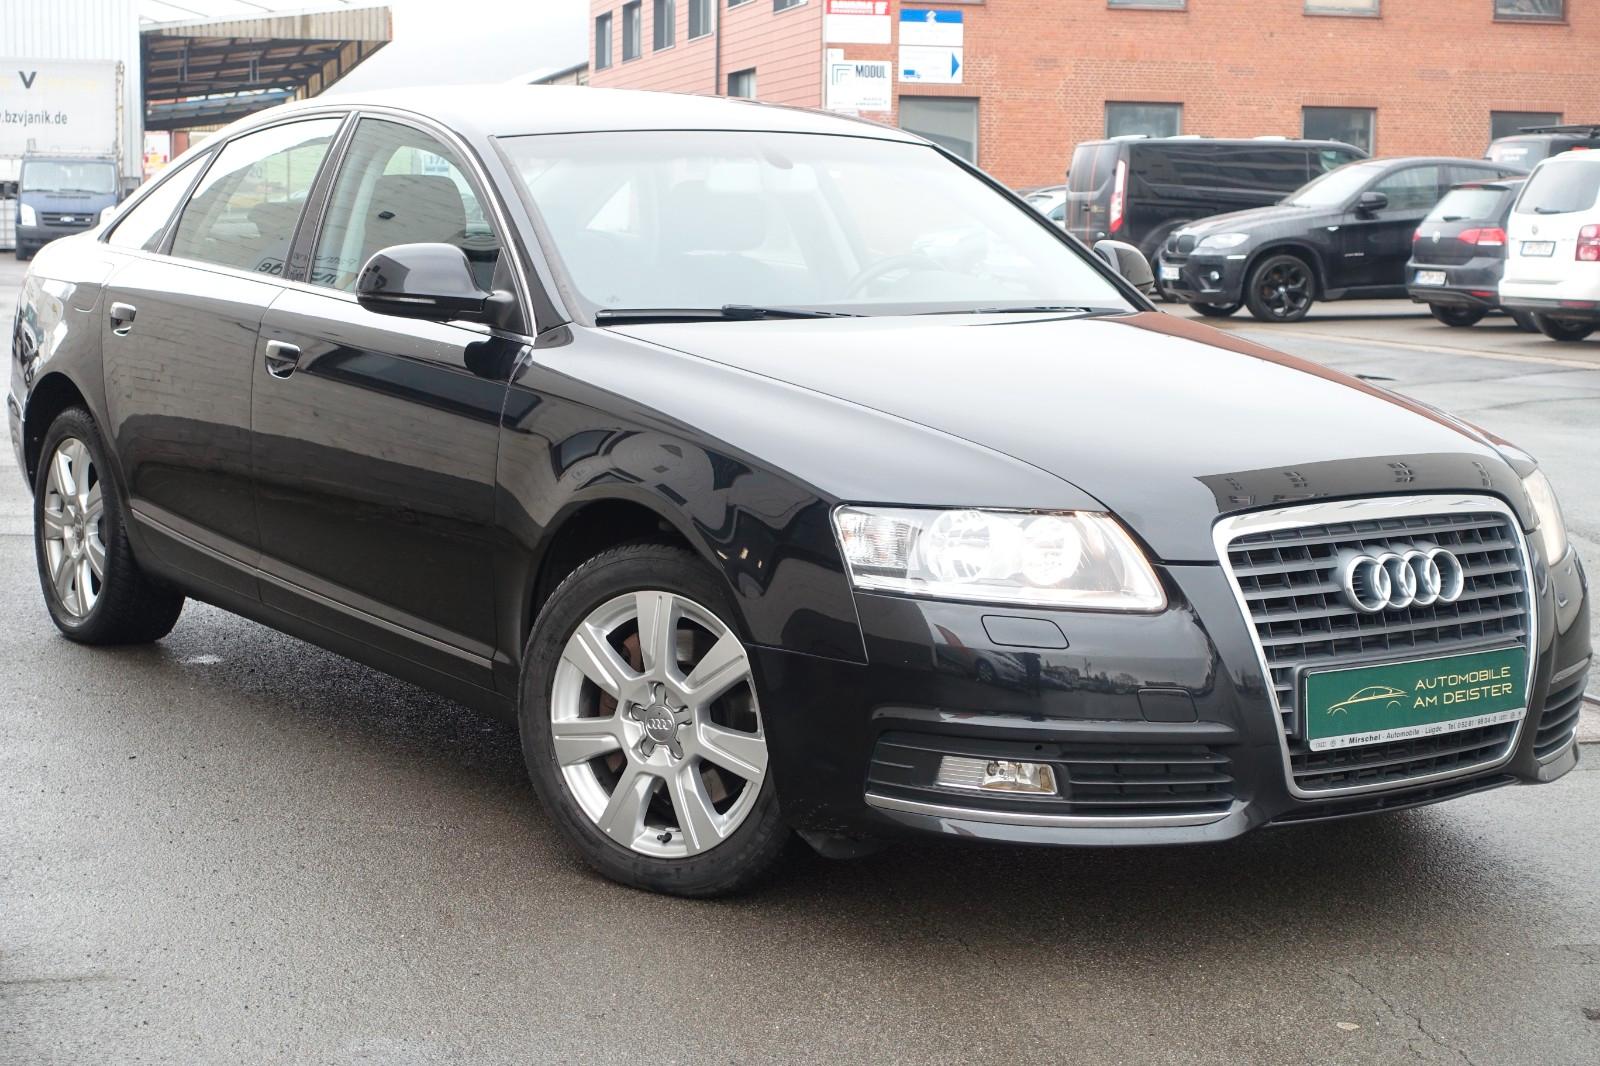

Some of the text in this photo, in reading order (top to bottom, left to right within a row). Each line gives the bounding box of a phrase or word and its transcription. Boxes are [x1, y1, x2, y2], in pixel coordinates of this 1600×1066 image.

[855, 64, 887, 79] MODUL
[0, 110, 68, 127] .bzvjanik.de
[1414, 666, 1511, 692] AUTOMOBILE
[1413, 683, 1513, 709] AM DEISTER
[1348, 733, 1381, 745] Mirschel
